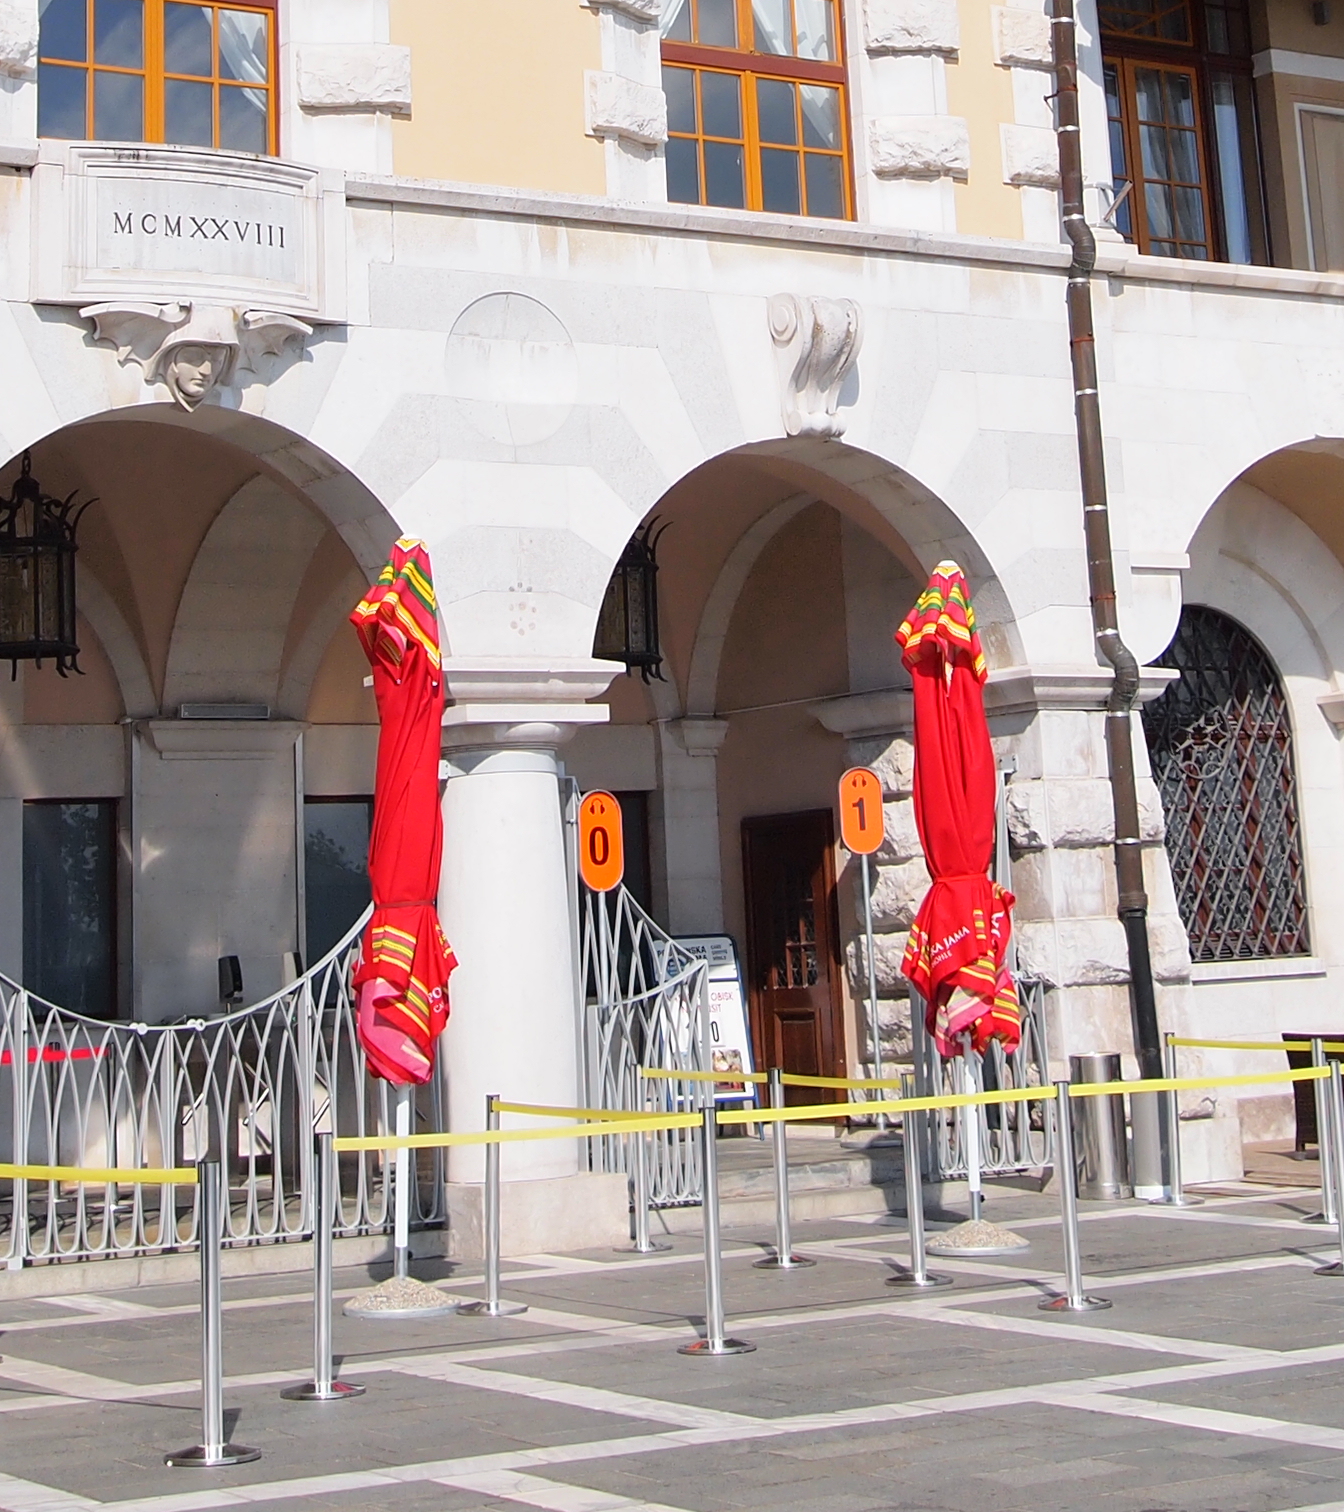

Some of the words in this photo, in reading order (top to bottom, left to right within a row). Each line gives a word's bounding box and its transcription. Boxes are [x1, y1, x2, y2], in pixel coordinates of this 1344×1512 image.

[112, 211, 286, 249] MCMXXVIII
[852, 797, 866, 831] 1
[589, 826, 609, 866] 0
[943, 926, 970, 949] JAMA
